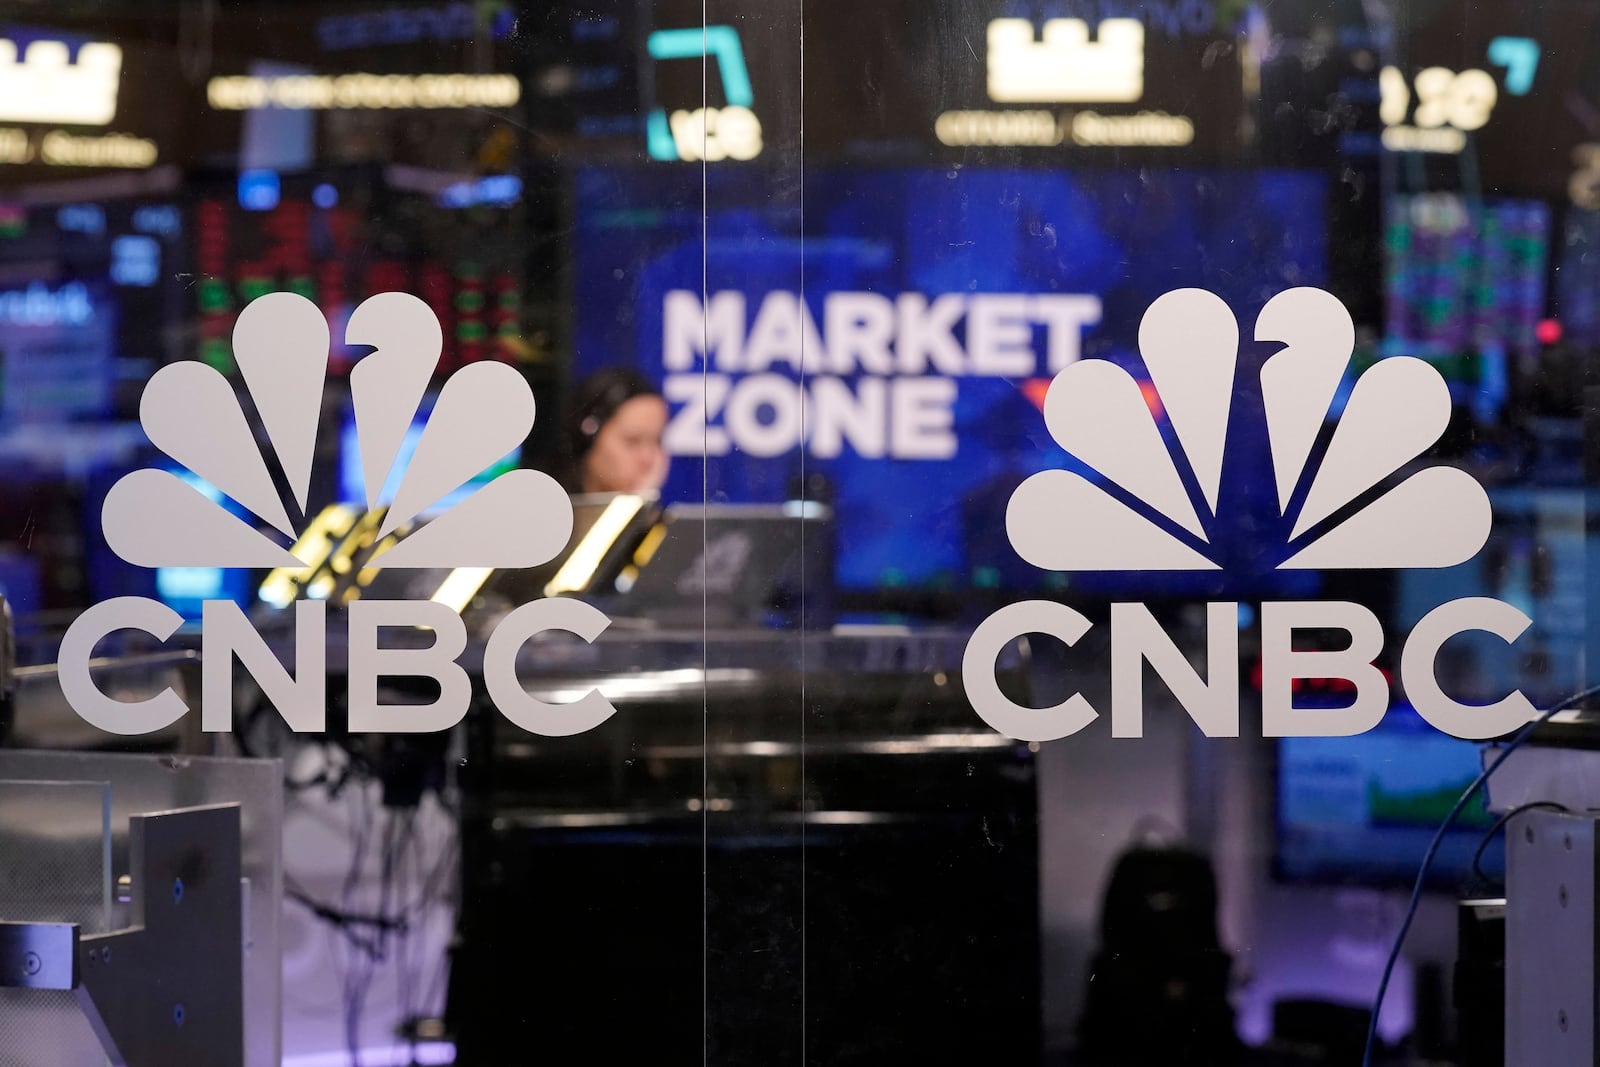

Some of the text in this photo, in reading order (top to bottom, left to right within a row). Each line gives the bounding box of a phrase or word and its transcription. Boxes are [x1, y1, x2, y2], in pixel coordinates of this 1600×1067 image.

[663, 291, 1101, 376] MARKET
[664, 375, 957, 458] ZONE
[58, 597, 617, 736] CNBC
[962, 597, 1537, 740] CNBC
